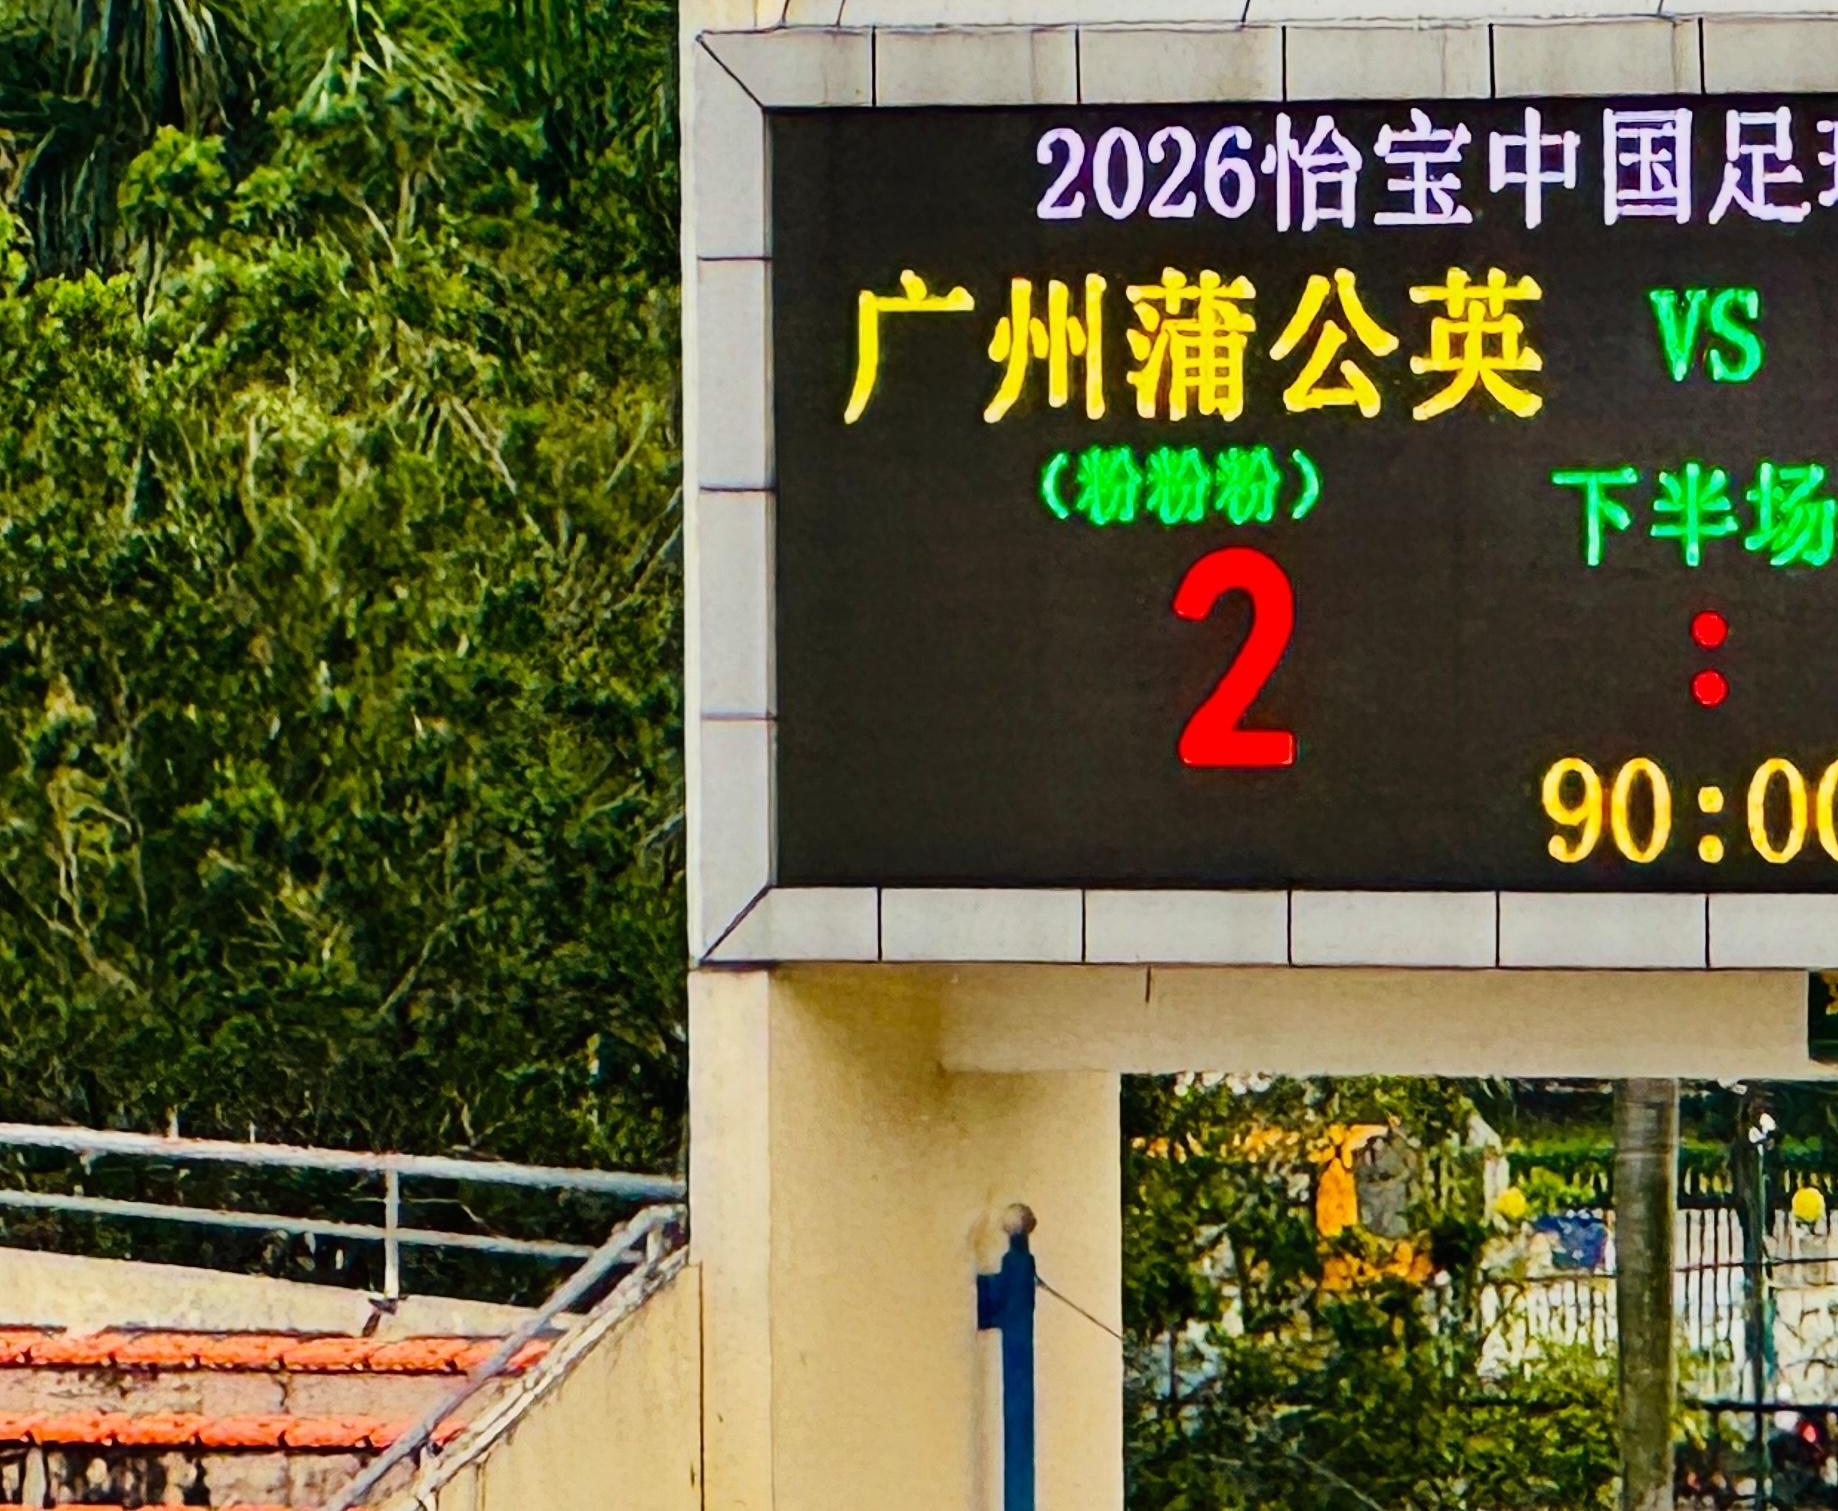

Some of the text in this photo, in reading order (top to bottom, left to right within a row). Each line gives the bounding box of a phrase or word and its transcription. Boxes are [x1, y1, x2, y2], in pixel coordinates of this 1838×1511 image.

[844, 267, 1543, 424] 广州蒲公英
[1650, 289, 1761, 380] VS
[1553, 463, 1838, 565] 下半场
[1174, 548, 1295, 767] 2
